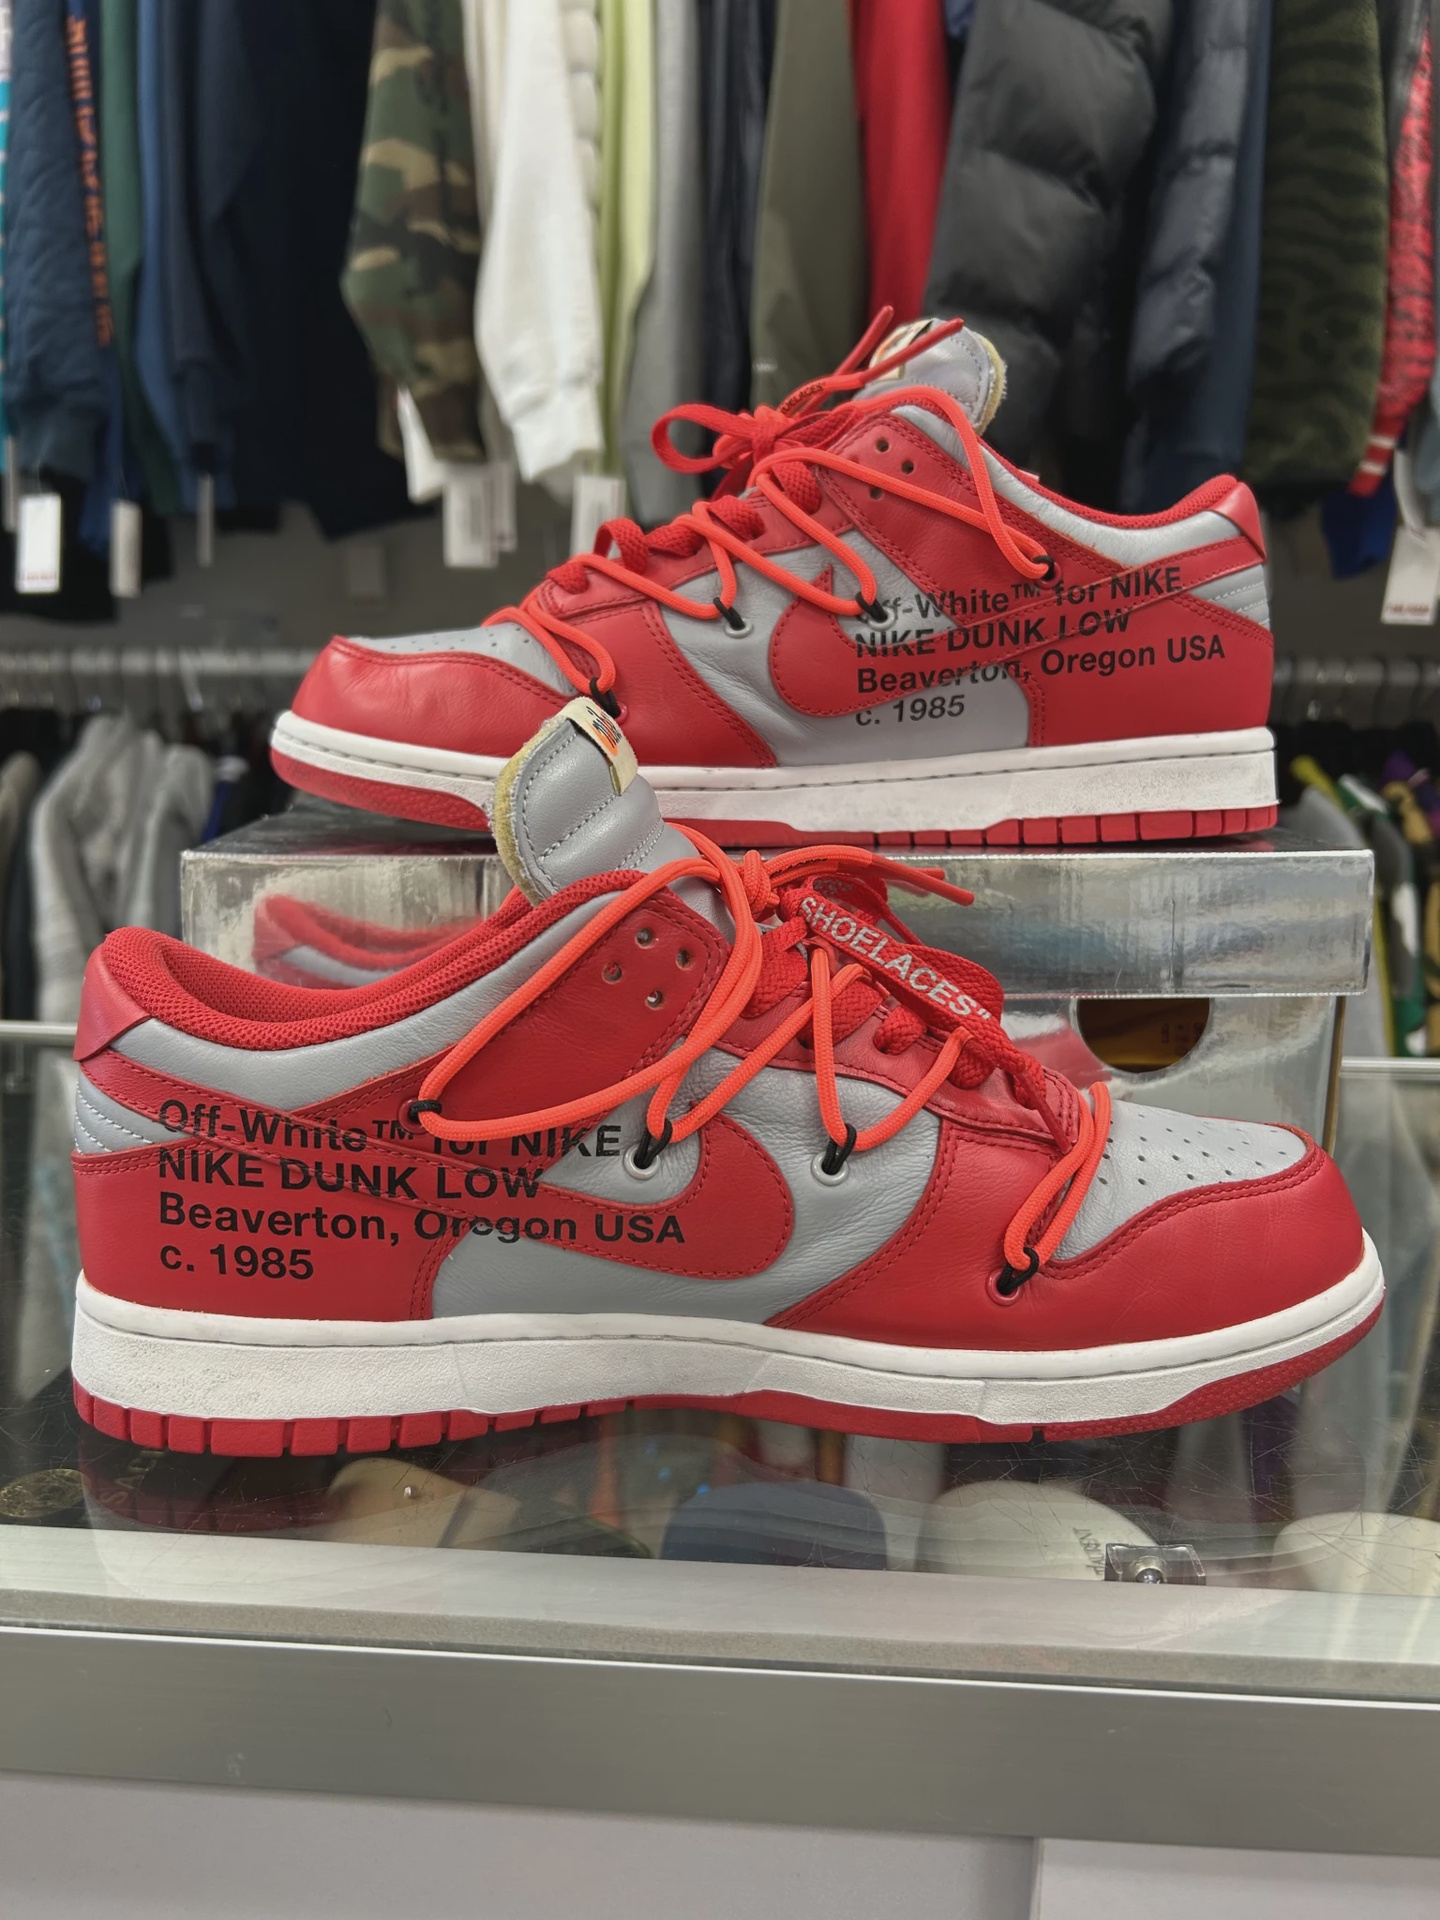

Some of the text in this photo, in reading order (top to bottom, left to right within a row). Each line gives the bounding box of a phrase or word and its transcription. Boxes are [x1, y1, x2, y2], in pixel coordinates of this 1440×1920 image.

[856, 566, 1182, 623] f-White™ for NIKE
[855, 607, 1132, 658] NIKE DUNK LOW
[857, 634, 1227, 694] Beaverton, Oregon USA
[856, 694, 966, 727] c. 1985
[511, 1125, 622, 1157] NIKE
[158, 1149, 543, 1199] NIKE DUNK LOW
[159, 1191, 686, 1247] Beaverton, Oregon USA
[159, 1245, 315, 1281] c. 1985
